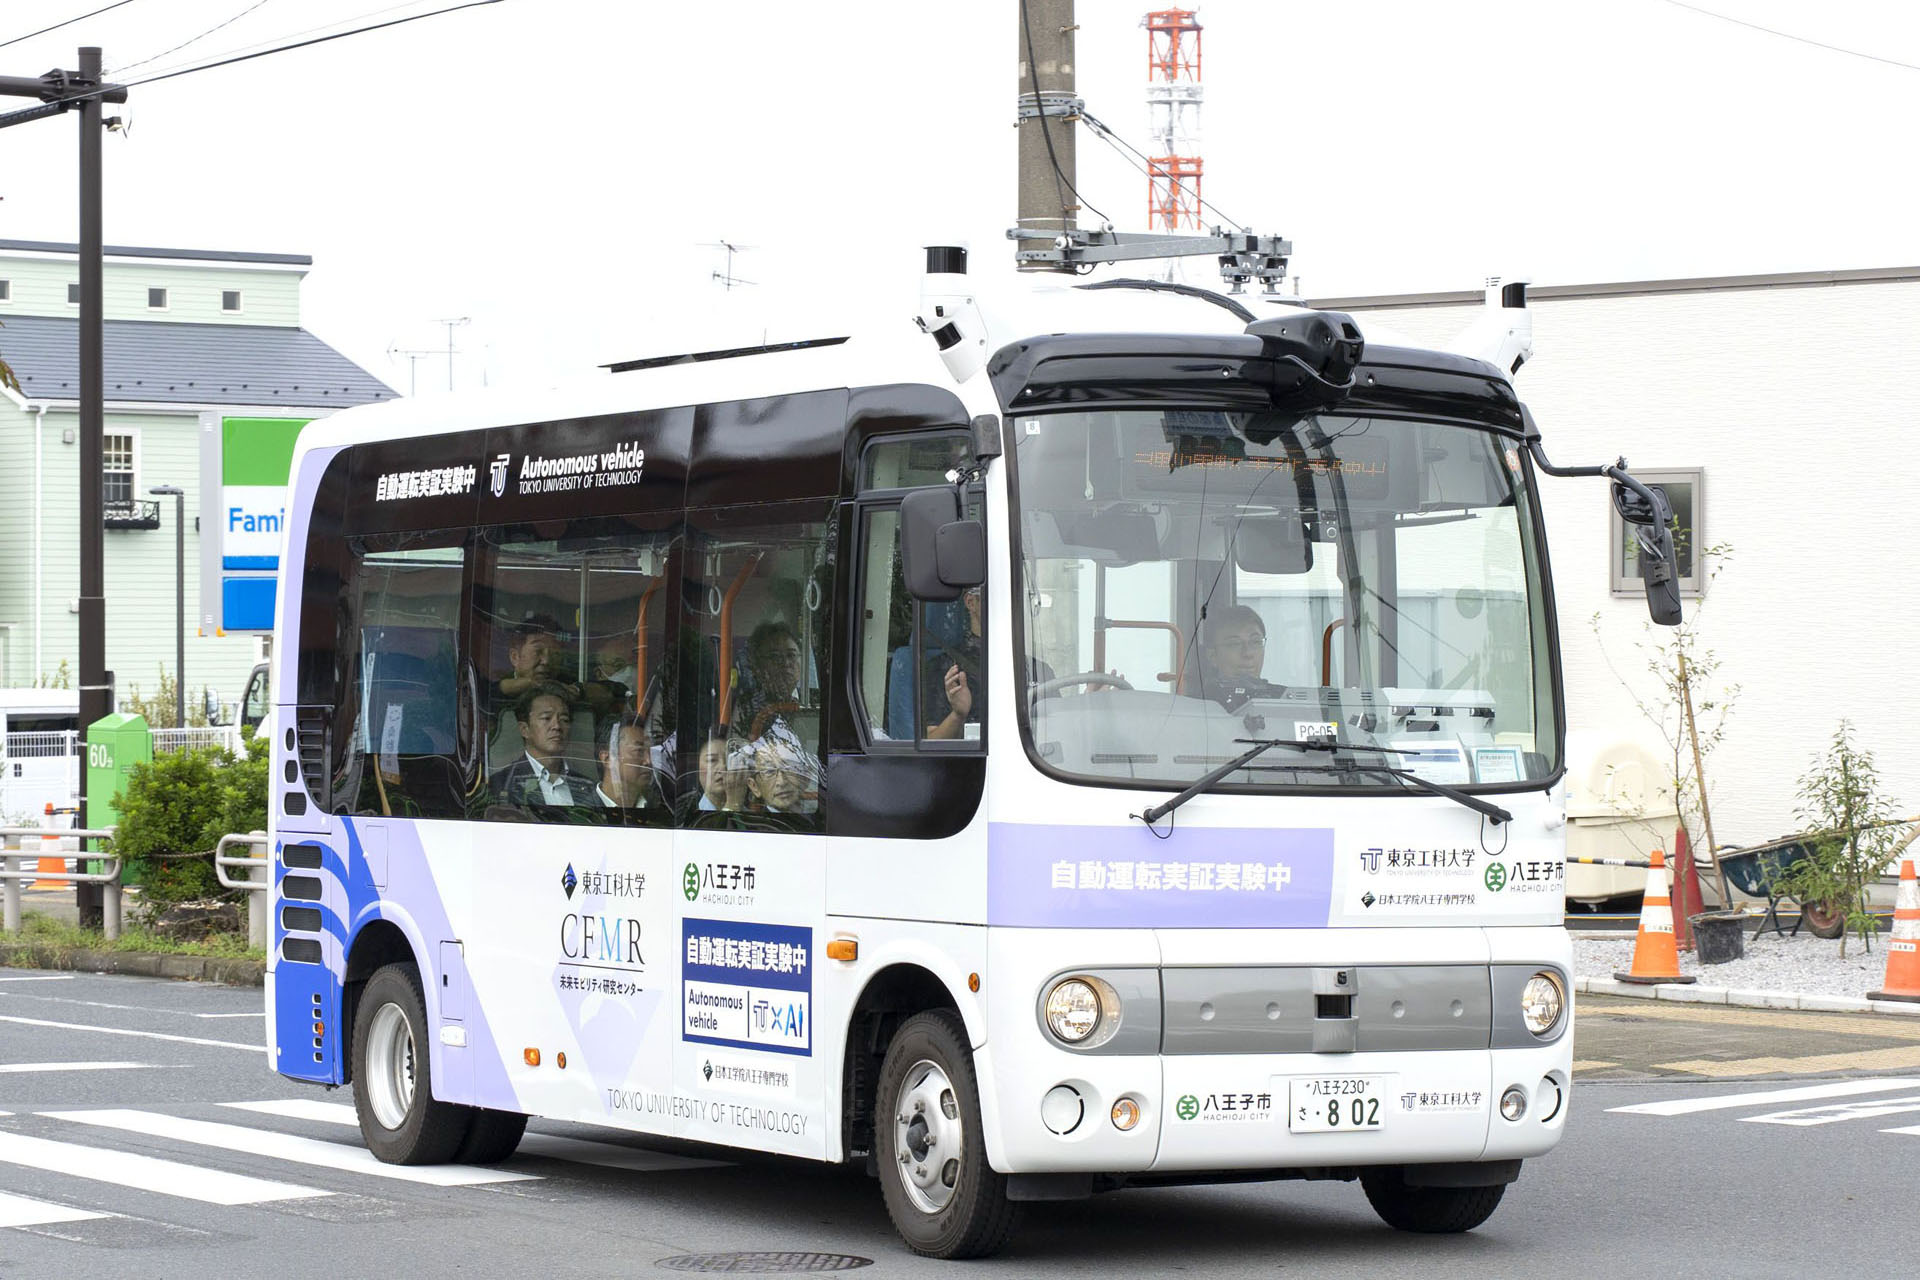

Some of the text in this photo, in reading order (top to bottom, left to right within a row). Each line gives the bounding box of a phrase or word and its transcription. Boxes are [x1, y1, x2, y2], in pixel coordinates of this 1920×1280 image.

[520, 441, 645, 480] Autonomous vehicle
[376, 465, 476, 501] 自動運転実証実験中
[519, 469, 643, 495] TOKYO UNIVERSITY OF TECHNOLOGY
[1386, 848, 1475, 868] 東京工科大学
[703, 864, 755, 891] 八王子市
[1051, 860, 1292, 891] 自動運転実証実験中
[1510, 861, 1564, 881] 八王子市
[582, 870, 645, 898] 東京工科大学
[1510, 884, 1548, 892] HACHIOJI
[703, 894, 754, 906] HACHIOJI CITY
[1378, 894, 1475, 905] 日本工学院八王子専門学校
[561, 913, 645, 965] CFMR
[687, 935, 807, 974] 自動運転実証実験中
[560, 974, 643, 996] 未来モビリティ研究センター
[688, 989, 743, 1010] Autonomous
[688, 1011, 718, 1031] vehicle
[715, 1065, 789, 1087] 日本工学院八王子専門学校
[1312, 1080, 1365, 1096] 八王子230
[1203, 1093, 1271, 1112] 八王子市
[1419, 1091, 1482, 1107] 東京工科大学
[608, 1088, 808, 1136] TOKYO UNIVERSITY OF TECHNOLOGY
[1203, 1112, 1271, 1121] HACHIOJI CITY
[1299, 1107, 1307, 1121] さ
